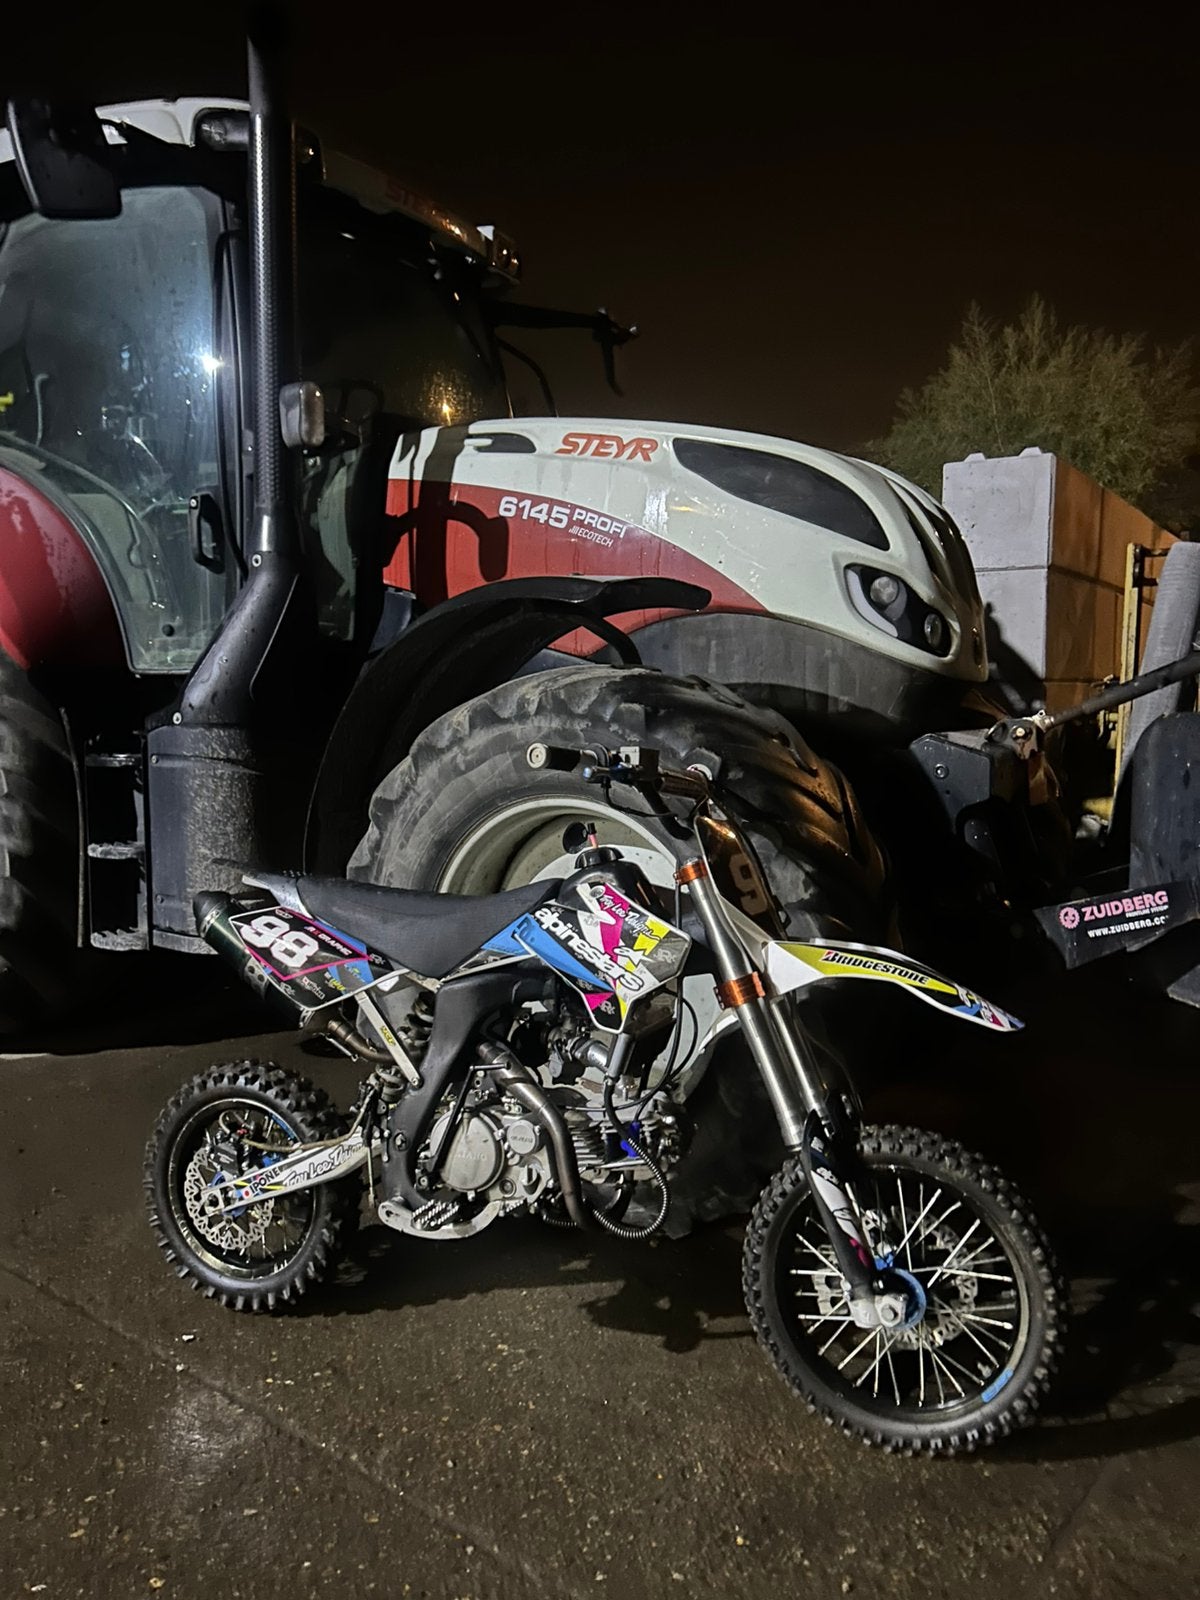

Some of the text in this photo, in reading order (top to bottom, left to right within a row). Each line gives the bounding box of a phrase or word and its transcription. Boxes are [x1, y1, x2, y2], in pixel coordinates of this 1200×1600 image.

[554, 432, 659, 462] STEYR
[499, 496, 627, 539] 6145 PROFI
[577, 527, 615, 548] ECOTECH
[611, 903, 627, 918] Lee
[1081, 891, 1169, 922] ZUIDBERG
[239, 915, 320, 969] 98
[1087, 915, 1170, 939] WWW.ZUIDBERG.CO
[534, 907, 644, 992] alpinestars
[821, 949, 930, 985] BRIDGESTONE
[250, 1166, 281, 1194] IPONE
[282, 1171, 308, 1187] Troy
[308, 1161, 333, 1179] Lee
